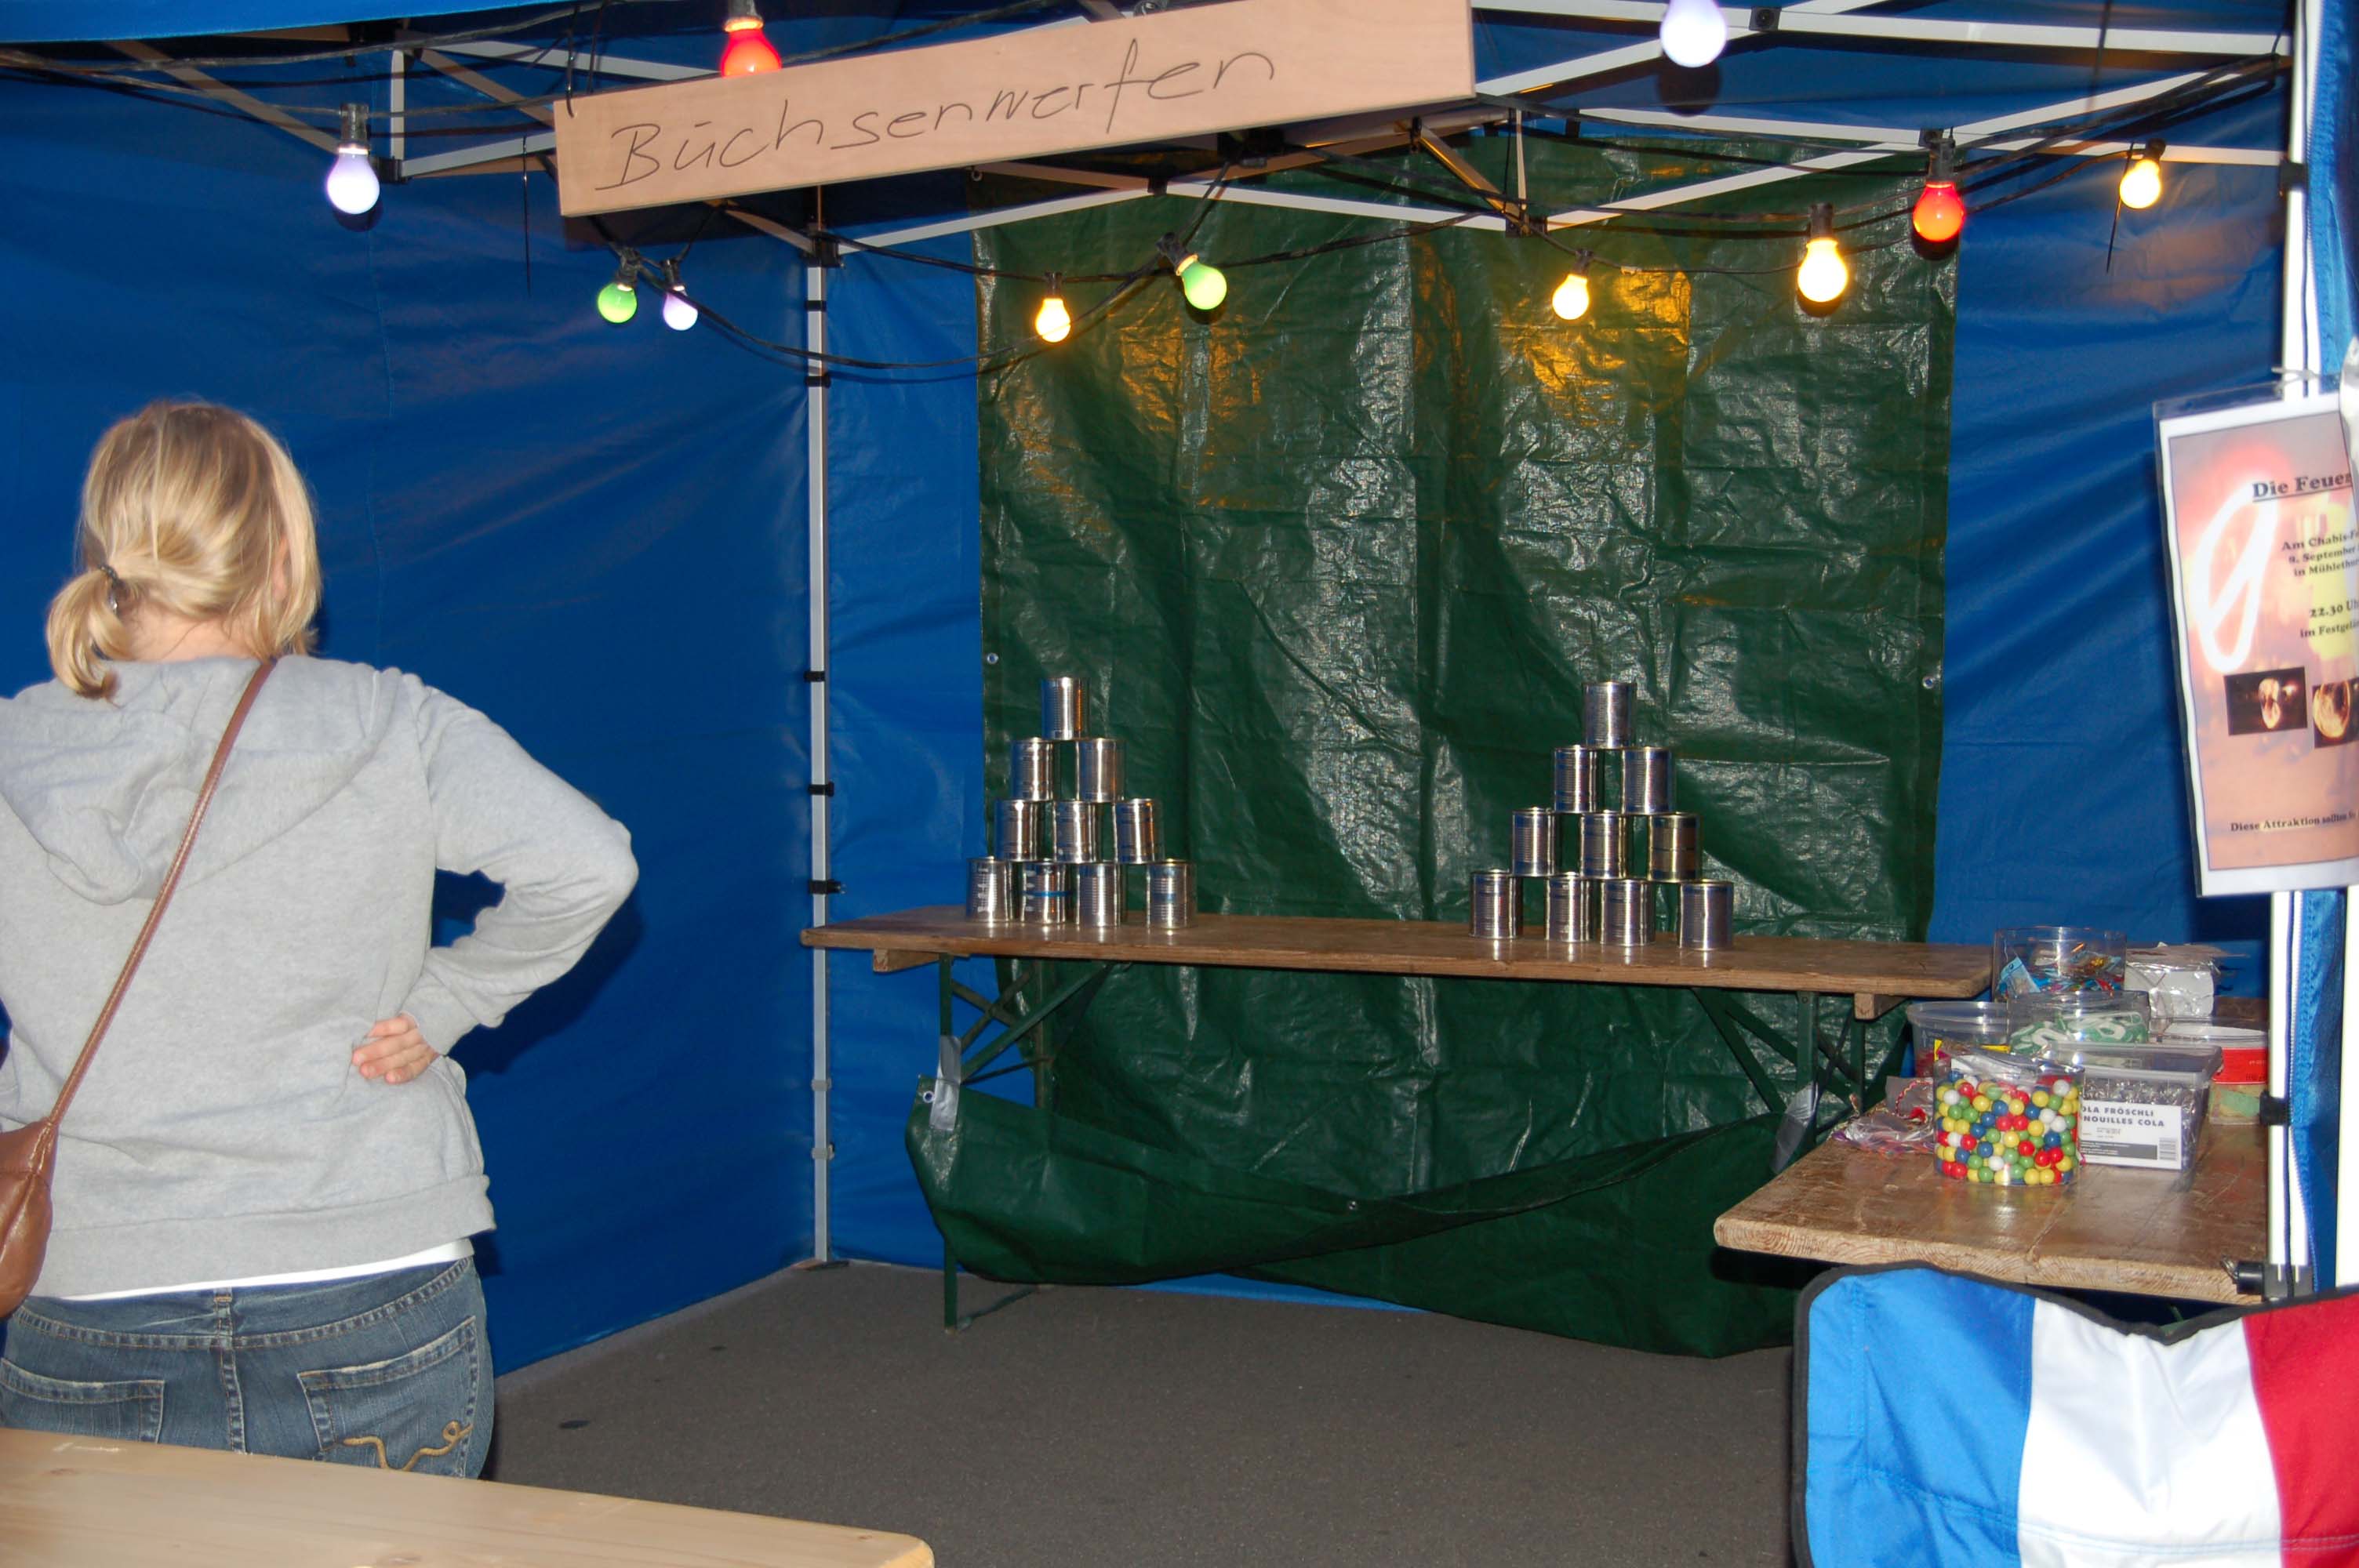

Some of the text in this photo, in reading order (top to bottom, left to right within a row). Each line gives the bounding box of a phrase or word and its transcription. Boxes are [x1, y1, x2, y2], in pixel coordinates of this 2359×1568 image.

[2252, 480, 2289, 498] Die
[2281, 541, 2305, 552] Am
[2303, 546, 2355, 562] September
[2294, 568, 2306, 577] in
[2309, 603, 2343, 619] 22.30
[2230, 822, 2260, 833] Diese
[2263, 817, 2320, 829] Attraktion
[2138, 1119, 2165, 1127] COLA
